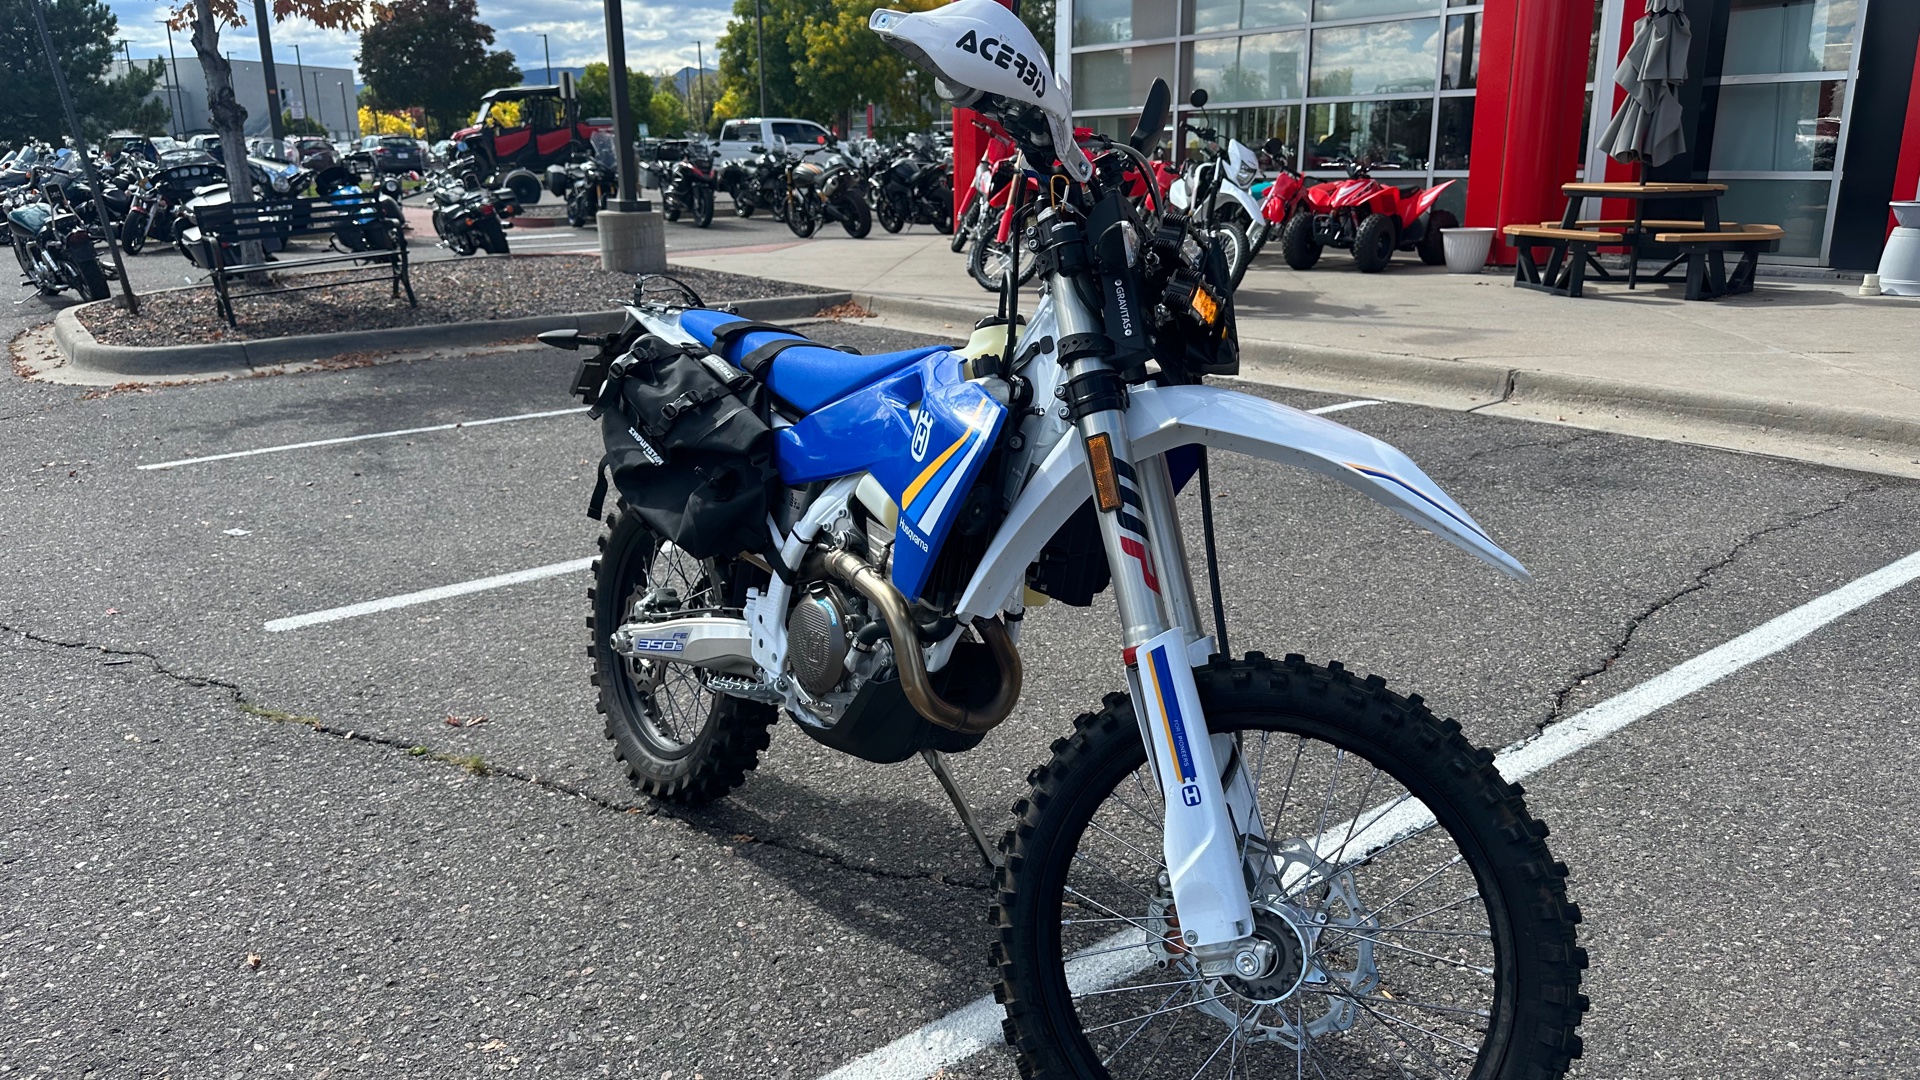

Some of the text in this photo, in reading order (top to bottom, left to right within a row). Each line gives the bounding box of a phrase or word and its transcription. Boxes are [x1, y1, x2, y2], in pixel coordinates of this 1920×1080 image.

[1115, 286, 1132, 330] GRAVITAS
[898, 516, 929, 553] Husqvarna
[1173, 719, 1190, 767] FOR PIONEERS
